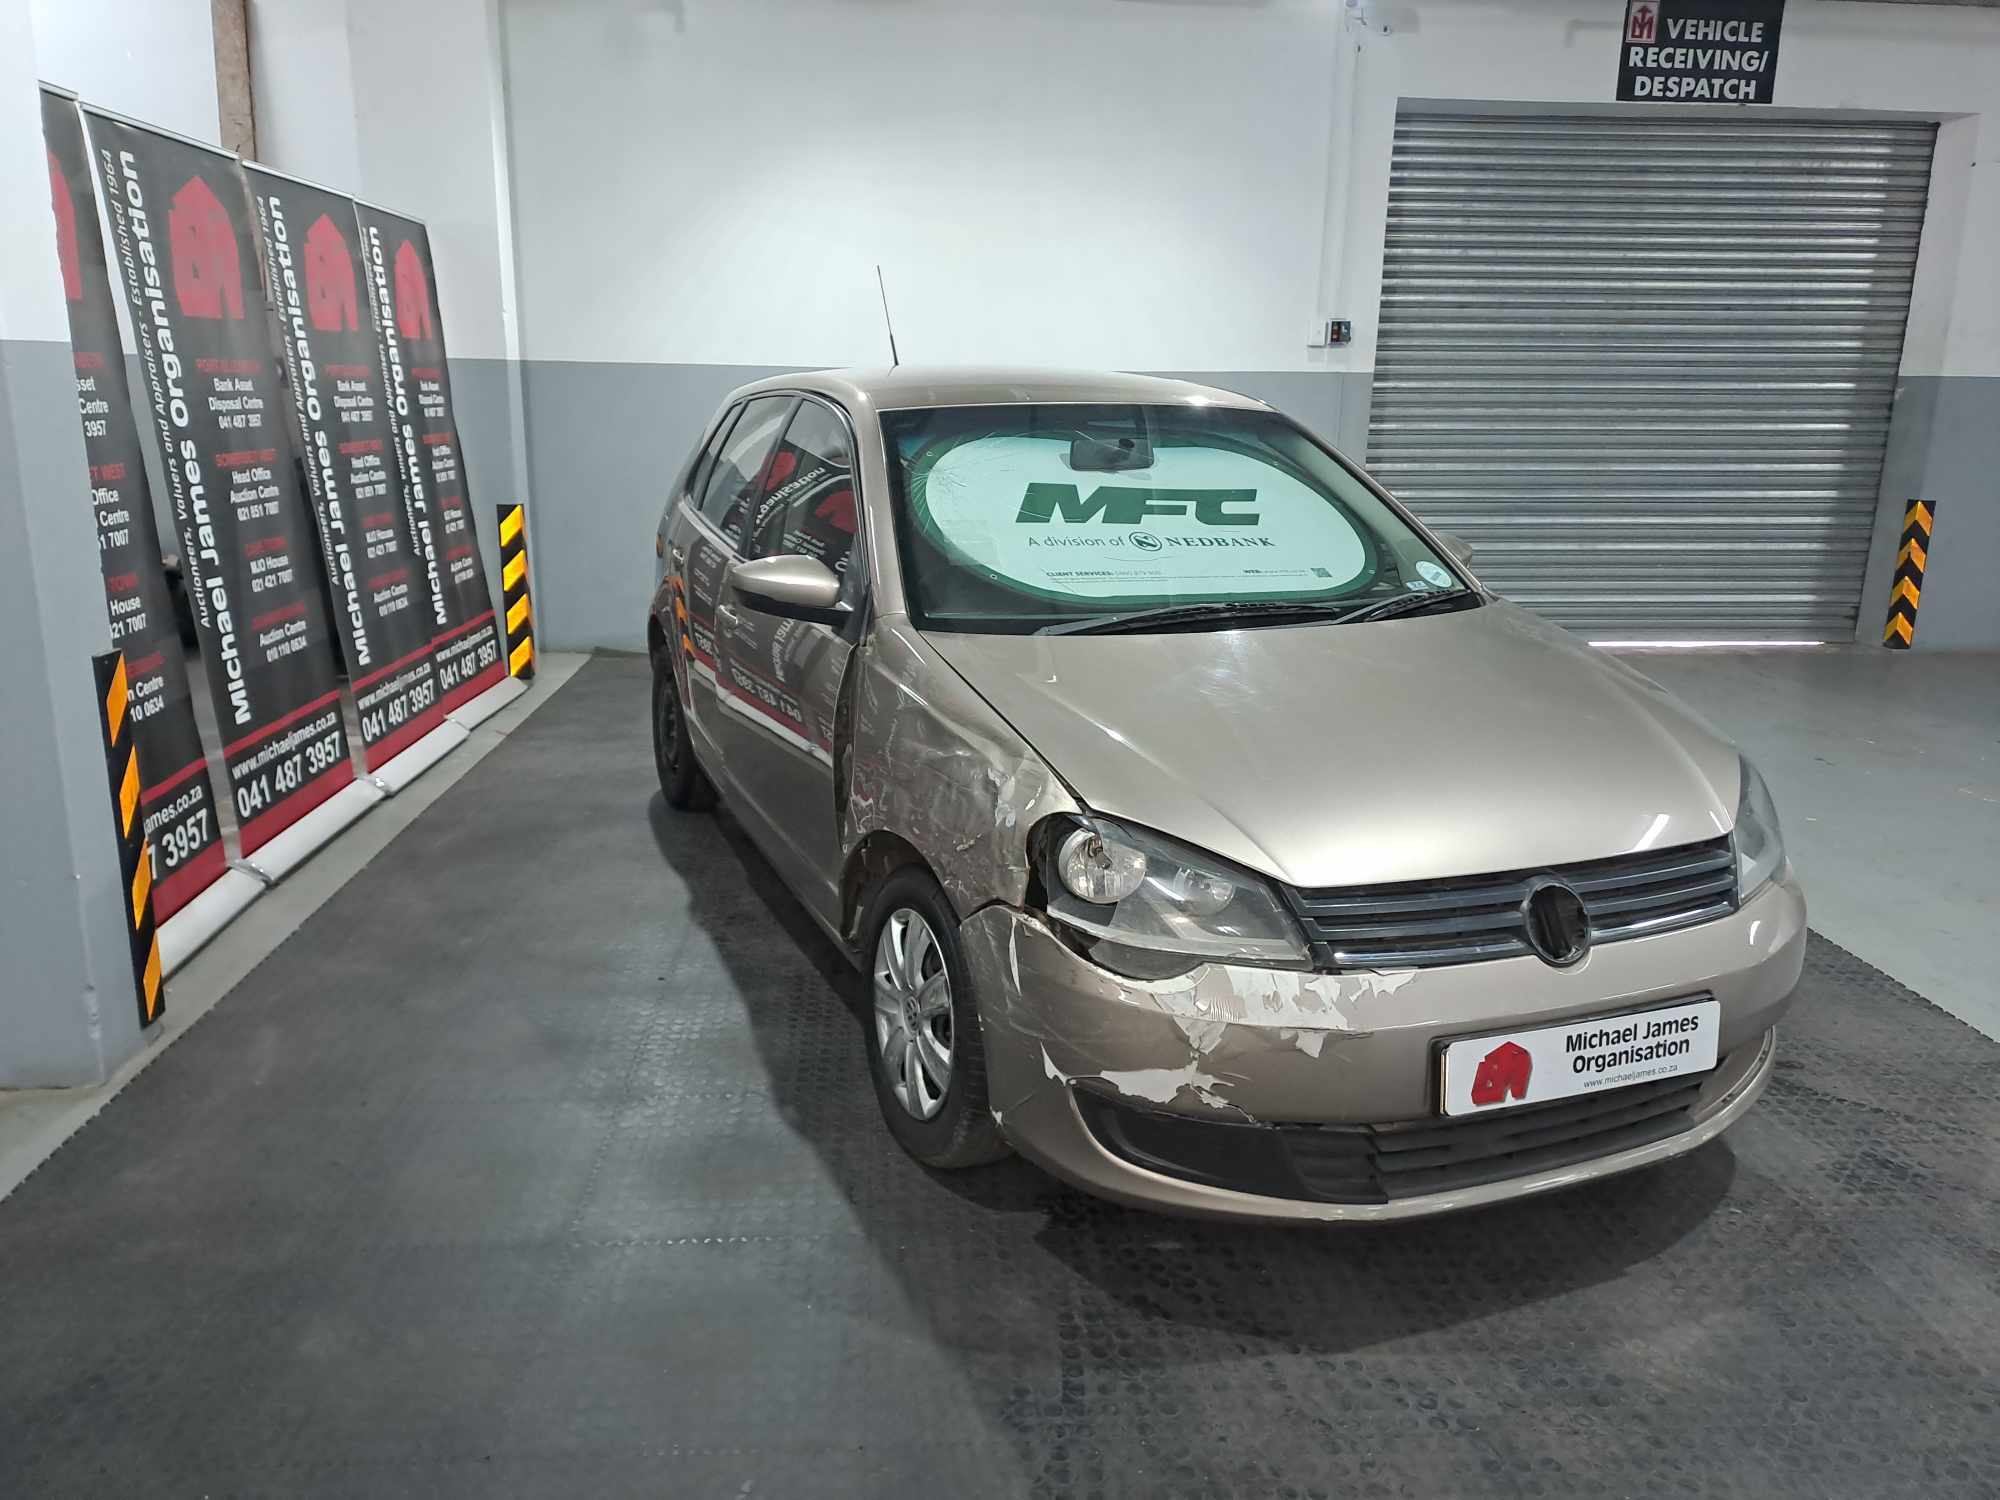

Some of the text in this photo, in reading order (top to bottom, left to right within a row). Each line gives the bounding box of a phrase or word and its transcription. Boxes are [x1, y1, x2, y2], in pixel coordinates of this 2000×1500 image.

[1667, 18, 1764, 43] VEHICLE
[1629, 47, 1768, 72] RECEIVING/
[1634, 75, 1757, 100] DESPATCH
[101, 148, 120, 195] 1964
[111, 199, 142, 306] Established
[368, 226, 408, 416] Organisation
[138, 322, 166, 416] Appraisers
[284, 335, 304, 411] Appraisers
[79, 398, 109, 415] Centre
[85, 420, 107, 437] 3957
[298, 412, 310, 441] and
[119, 150, 252, 725] Michael James Organisation
[158, 418, 173, 453] and
[268, 196, 371, 666] Michael James Organisation
[168, 458, 188, 520] Valuers
[304, 444, 321, 496] Valuers
[402, 423, 427, 513] James
[100, 509, 130, 527] Centre
[1015, 482, 1260, 526] MFC
[108, 529, 129, 547] 7007
[1028, 535, 1275, 547] A division of NEDBANK
[183, 526, 211, 629] Auctioneers,
[417, 520, 448, 625] Michael
[110, 596, 142, 616] House
[126, 613, 147, 633] 7007
[136, 674, 165, 697] Centre
[439, 639, 496, 690] 041 487 3957
[362, 678, 434, 743] 041 487 3957
[232, 711, 337, 780] www.michaeljames.co.za
[237, 731, 340, 818] 041 487 3957
[162, 808, 209, 868] 3957
[1565, 1014, 1699, 1053] Michael James
[1572, 1036, 1690, 1075] Organisation
[1583, 1063, 1678, 1089] www.michaeljames.co.za
